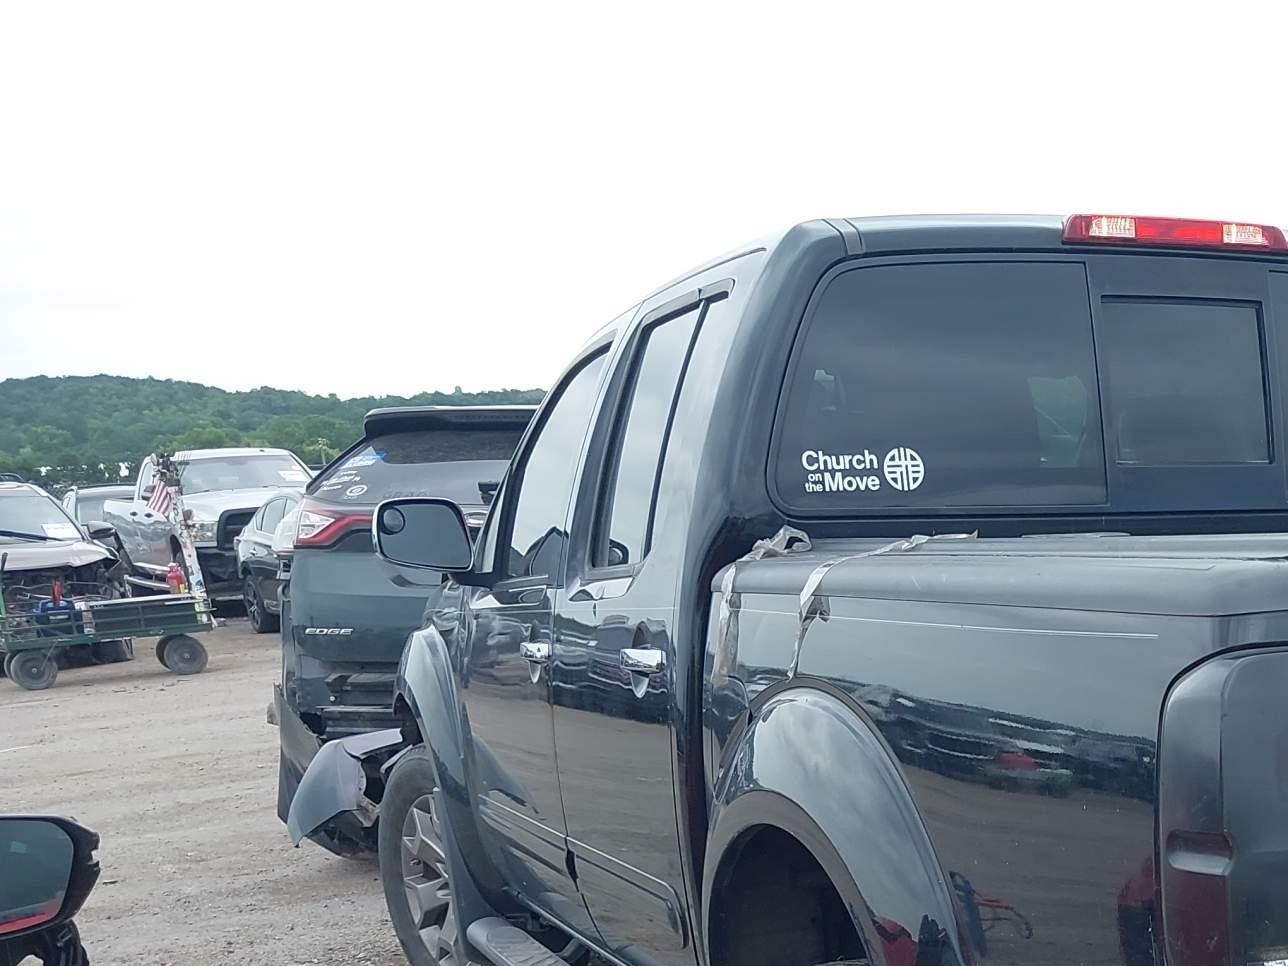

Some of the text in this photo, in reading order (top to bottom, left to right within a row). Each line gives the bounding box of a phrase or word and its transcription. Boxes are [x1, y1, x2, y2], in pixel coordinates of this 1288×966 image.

[801, 449, 879, 471] Church
[804, 472, 880, 492] the Move
[807, 473, 822, 482] on
[304, 627, 354, 635] EDGE
